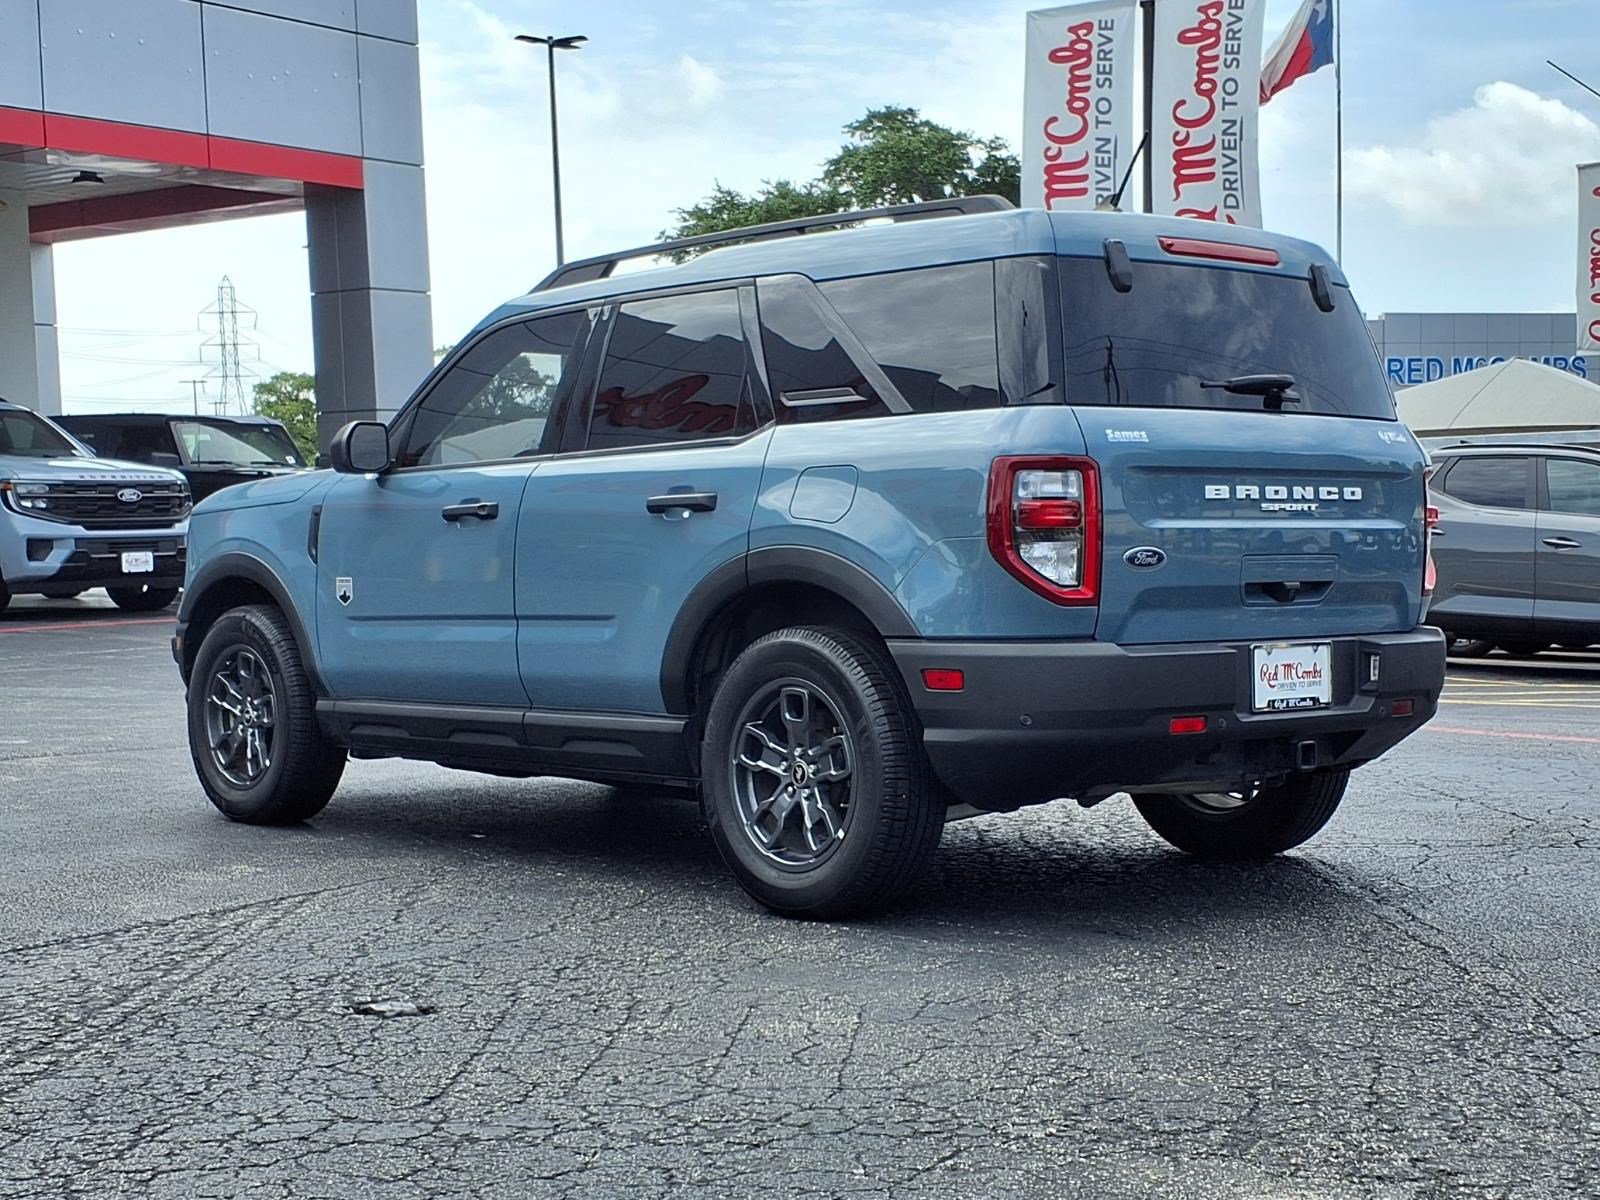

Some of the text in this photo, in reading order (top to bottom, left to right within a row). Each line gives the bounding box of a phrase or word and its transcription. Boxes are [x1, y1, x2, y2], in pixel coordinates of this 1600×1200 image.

[1095, 19, 1114, 206] RIVEN TO SERVE
[1172, 0, 1225, 201] McCombs
[1222, 0, 1245, 210] DRIVEN TO SERVE
[1044, 21, 1094, 210] McCombs
[1386, 357, 1443, 384] RED
[1204, 484, 1362, 500] BRONCO
[1260, 502, 1319, 512] SPORT
[1135, 551, 1159, 565] Ford
[1260, 661, 1322, 688] Red McCombs
[1277, 680, 1322, 689] DRIVEN TO SERVE
